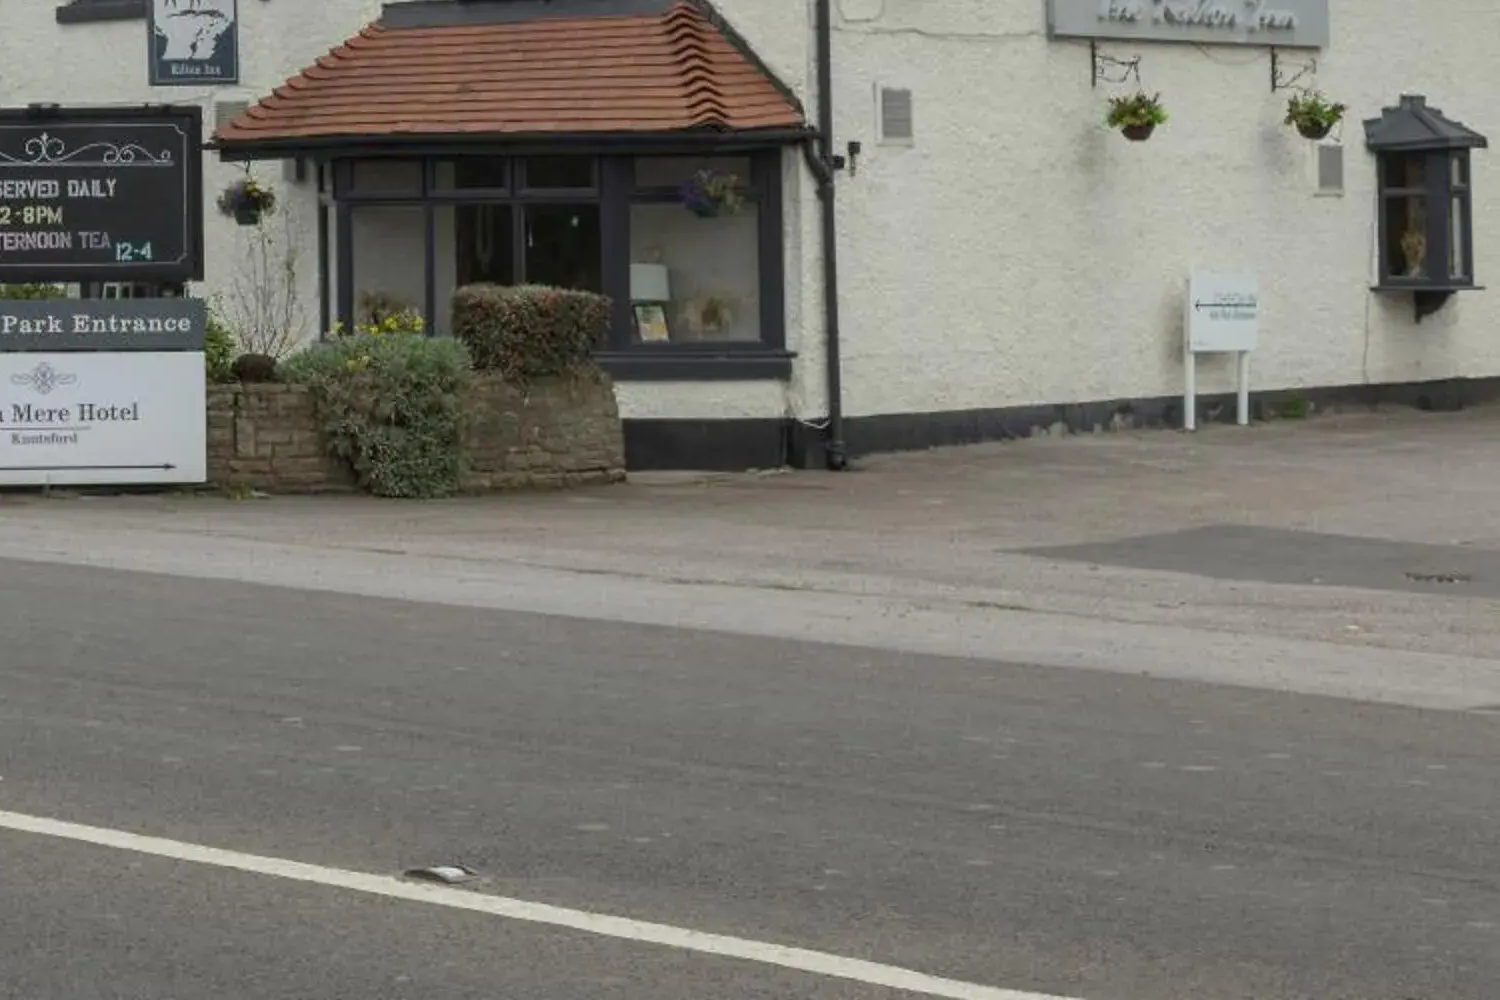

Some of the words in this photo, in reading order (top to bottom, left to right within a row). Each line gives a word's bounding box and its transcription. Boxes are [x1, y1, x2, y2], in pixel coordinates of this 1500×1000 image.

[67, 178, 117, 197] DAILY
[78, 231, 112, 249] TEA
[115, 242, 152, 261] 12-4
[1, 315, 64, 334] Park
[71, 314, 192, 334] Entrance
[11, 404, 71, 422] Mere
[77, 402, 141, 422] Hotel
